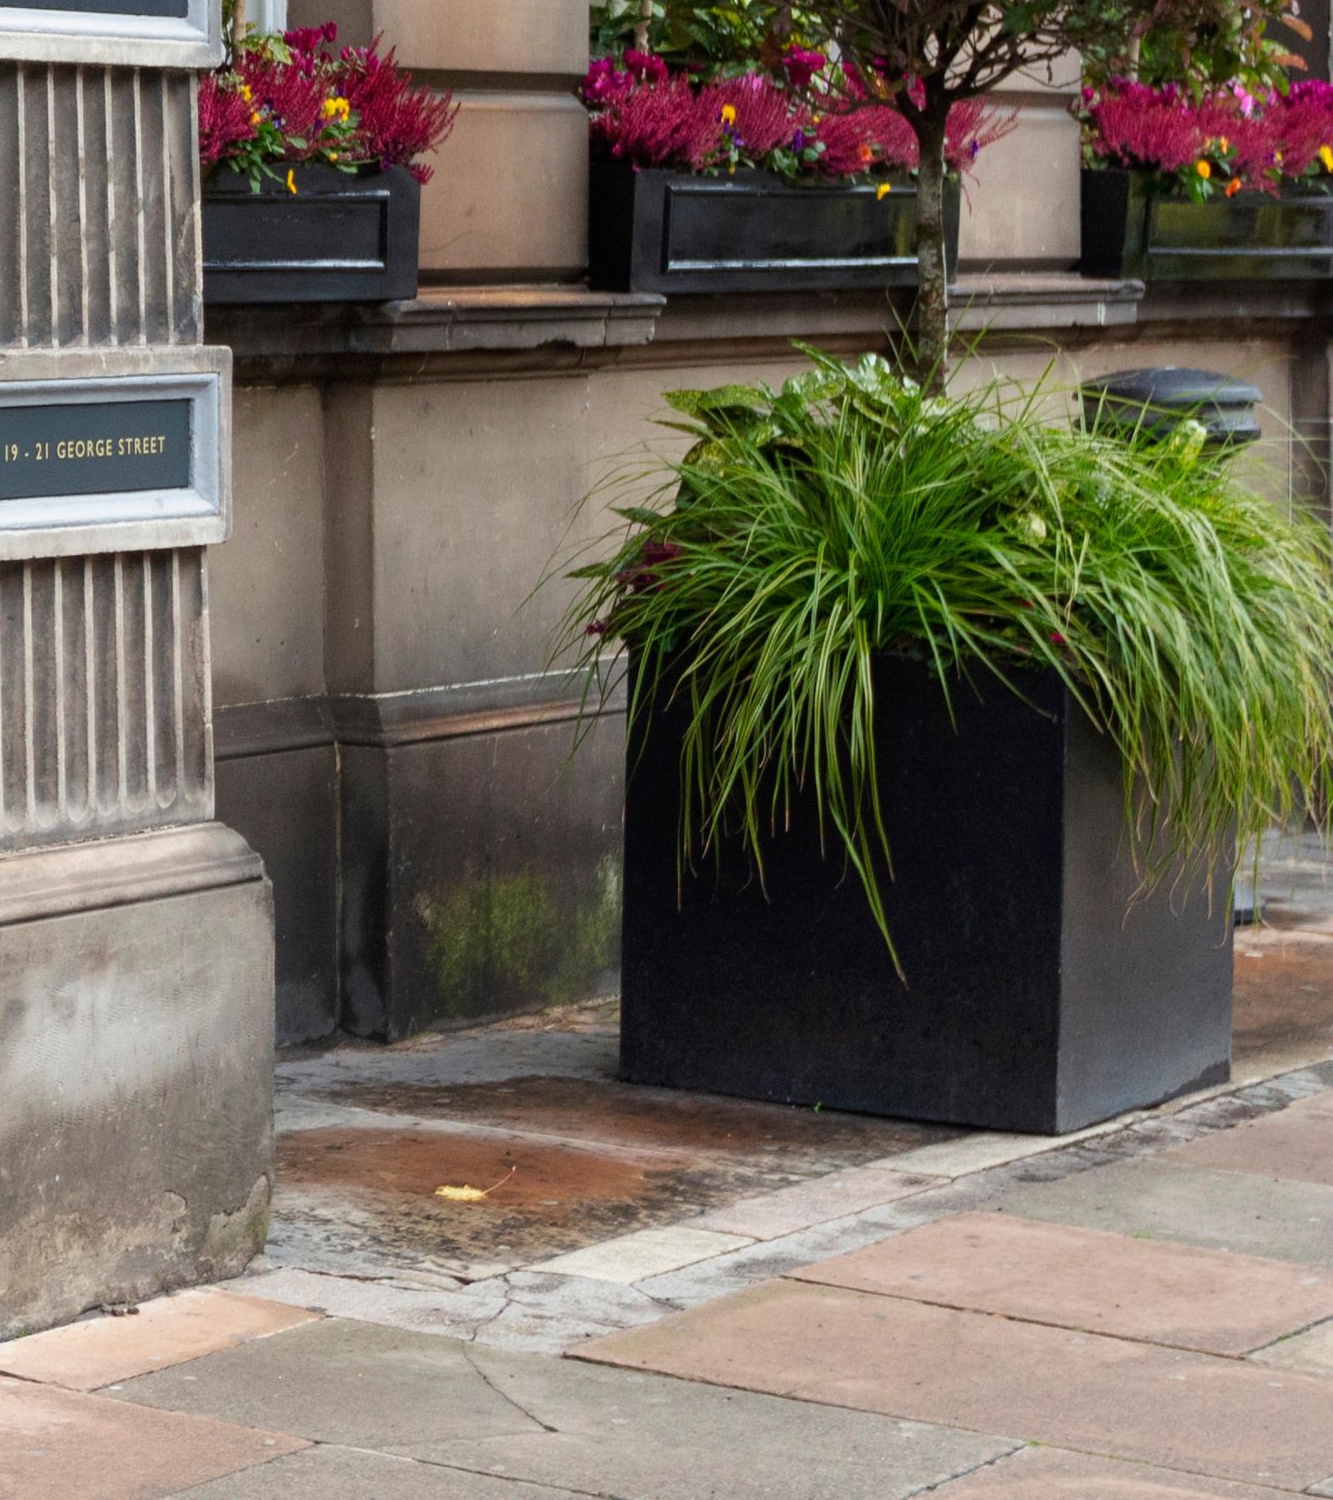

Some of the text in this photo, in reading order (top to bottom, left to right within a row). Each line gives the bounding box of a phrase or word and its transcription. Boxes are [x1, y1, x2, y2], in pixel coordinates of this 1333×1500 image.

[5, 444, 19, 462] 19
[35, 442, 50, 461] 21
[56, 438, 113, 459] GEORGE
[118, 436, 166, 456] STREET
